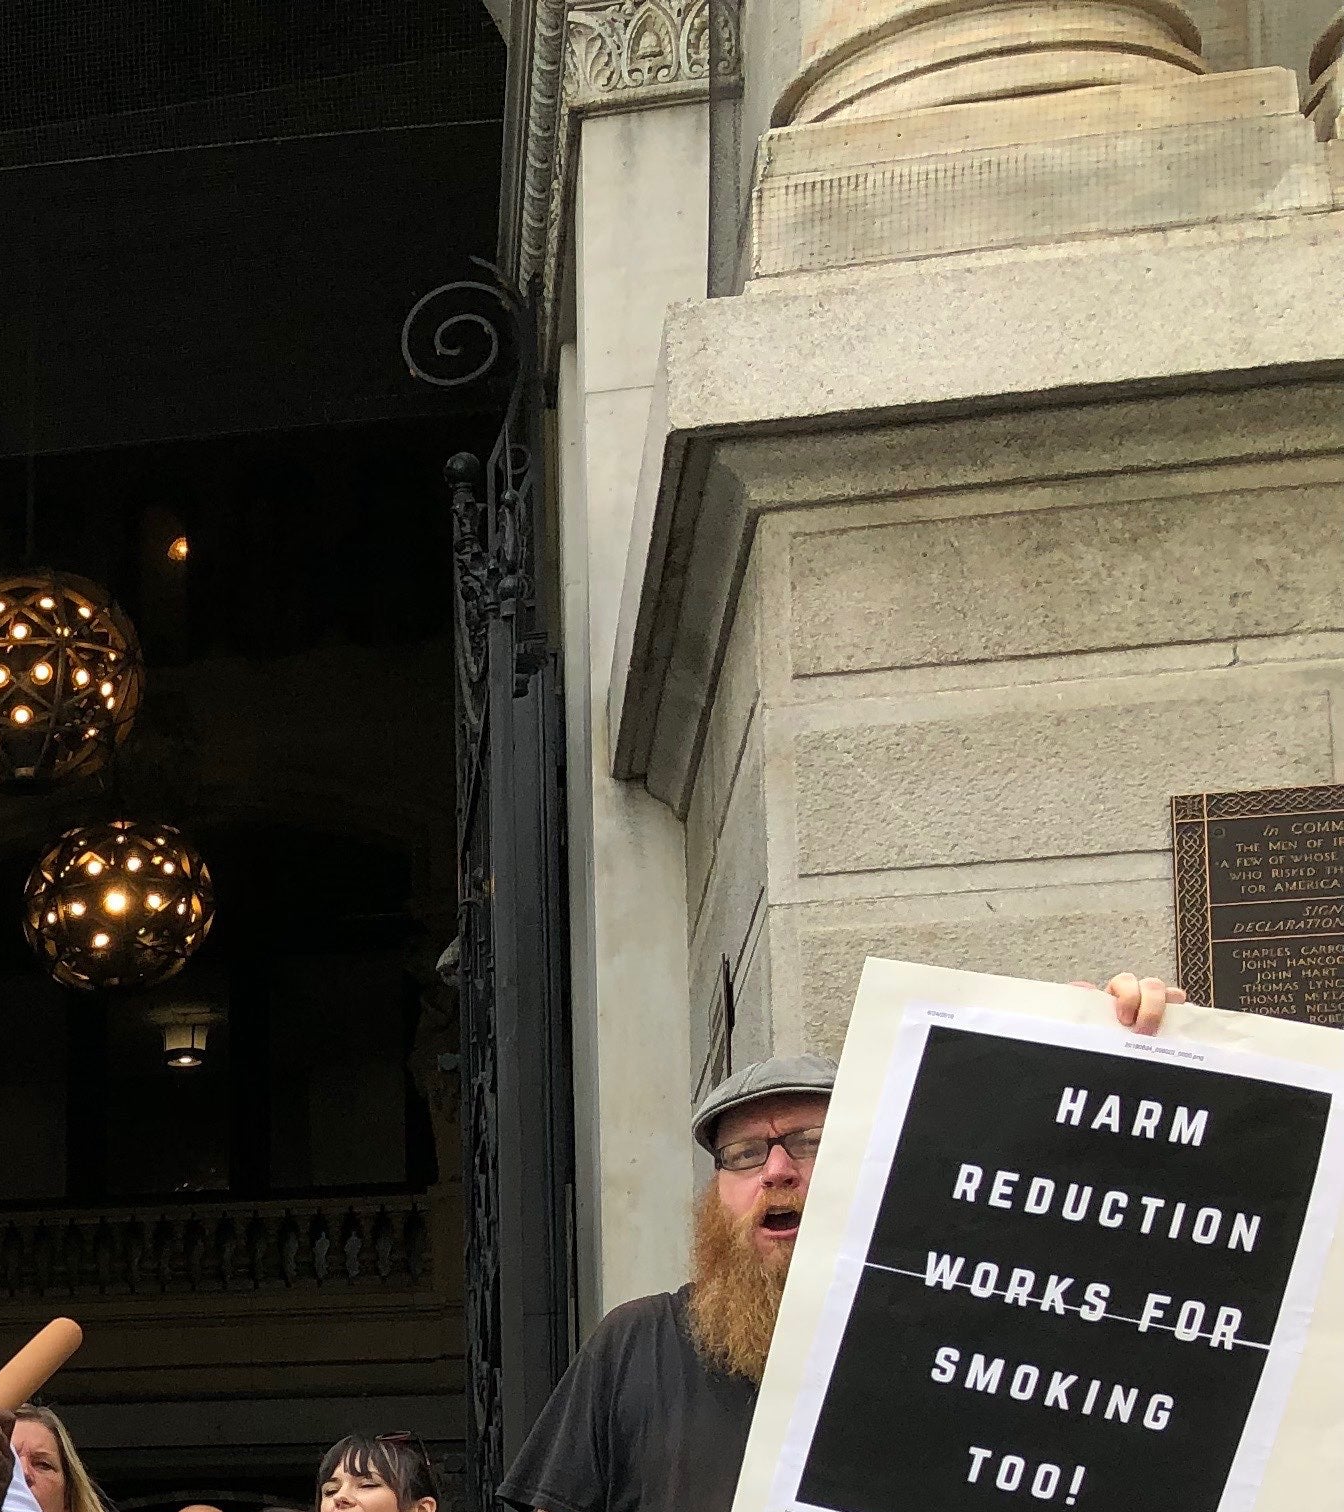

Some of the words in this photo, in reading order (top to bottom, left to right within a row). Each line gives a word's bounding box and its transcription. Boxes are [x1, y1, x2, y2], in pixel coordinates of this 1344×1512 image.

[1268, 840, 1298, 851] MEN
[1306, 838, 1323, 848] OF
[1236, 856, 1263, 868] FEW
[1268, 855, 1286, 865] OF
[1290, 851, 1337, 863] WHOSE
[1229, 870, 1262, 880] WHO
[1271, 867, 1316, 878] RISKED
[1240, 884, 1266, 894] FOR
[1274, 878, 1341, 892] AMERICA
[1232, 947, 1291, 959] CHARLES
[1241, 960, 1277, 974] JOHN
[1256, 970, 1292, 983] JOHN
[1301, 968, 1338, 978] HART
[1242, 981, 1299, 993] THOMAS
[1239, 993, 1294, 1005] THOMAS
[1054, 1085, 1210, 1148] HARM
[951, 1162, 1263, 1254] REDUCTION
[921, 1249, 1113, 1323] WORKS
[1136, 1291, 1244, 1352] FOR
[930, 1344, 1175, 1433] SMOKING
[966, 1445, 1087, 1507] TOO!
